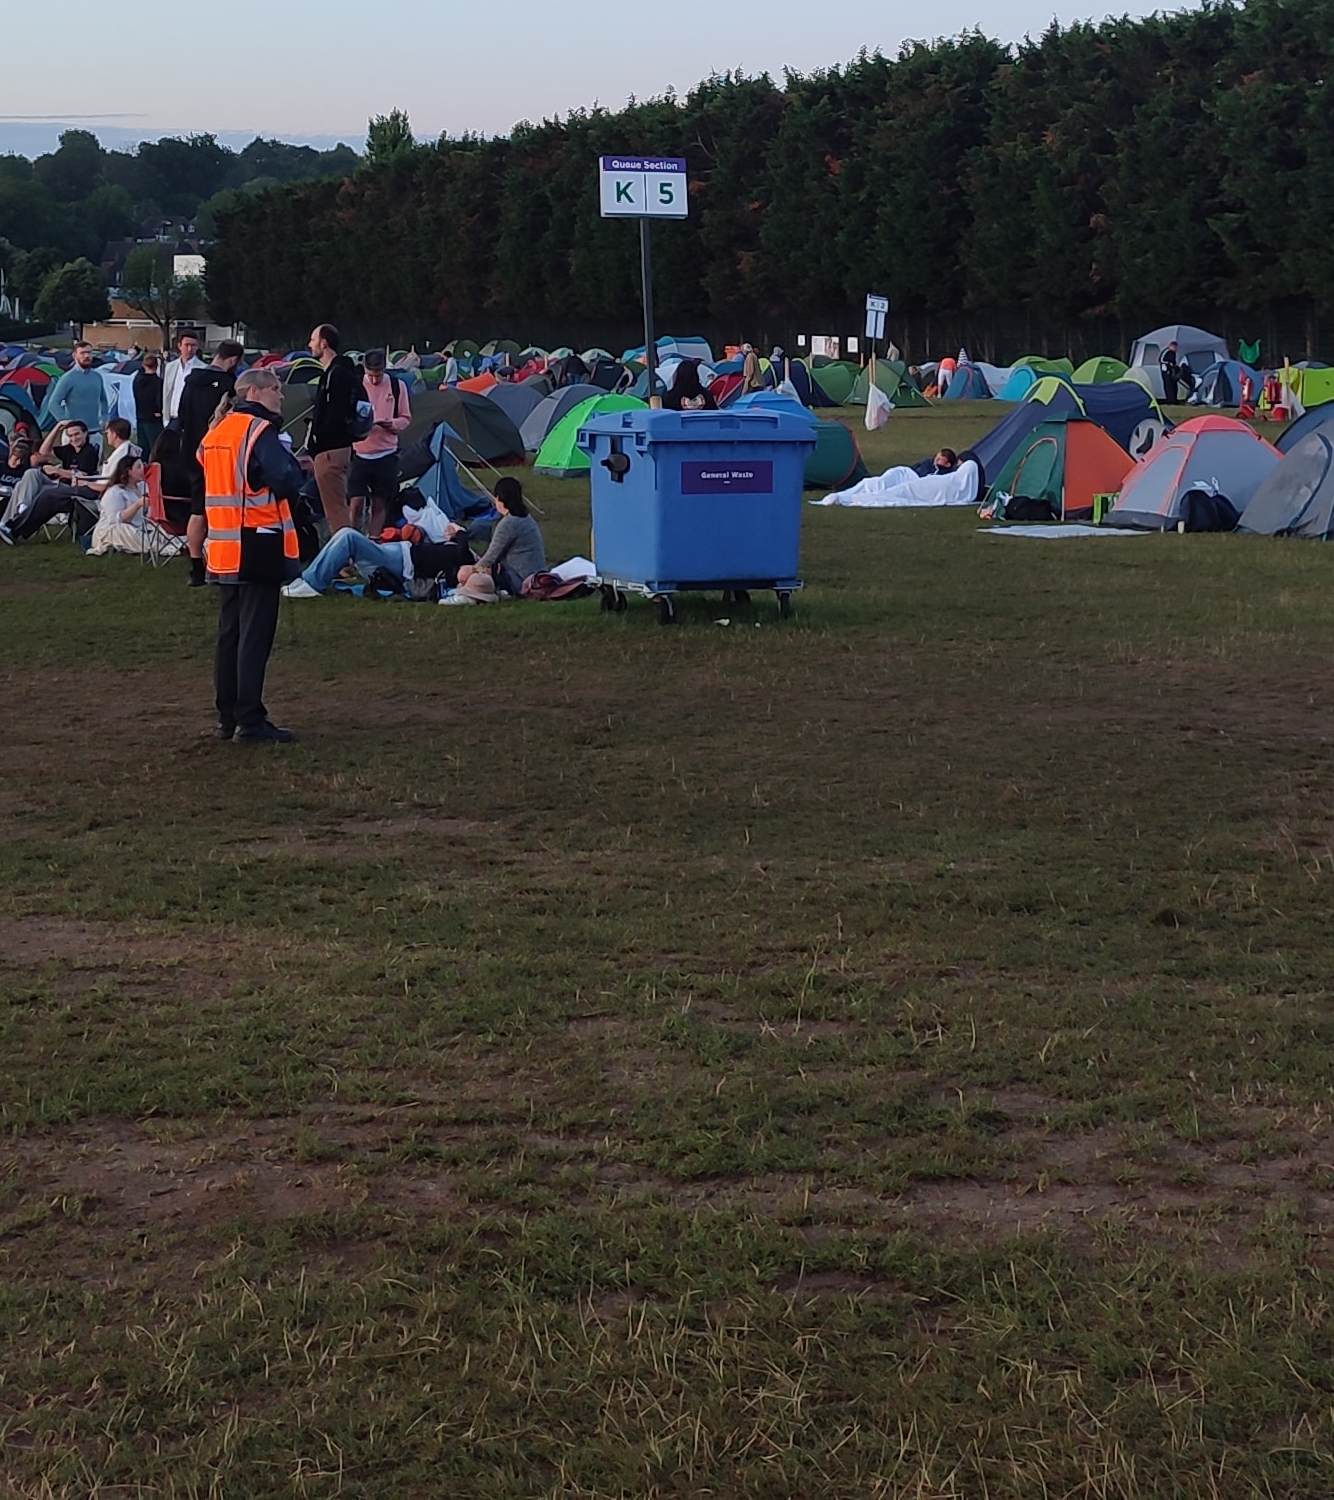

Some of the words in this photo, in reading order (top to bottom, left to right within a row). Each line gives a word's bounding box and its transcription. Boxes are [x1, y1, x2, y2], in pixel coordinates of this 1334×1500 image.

[611, 160, 642, 169] Queue
[643, 160, 678, 170] Section
[615, 181, 635, 204] K
[659, 182, 674, 205] 5
[700, 471, 730, 479] General
